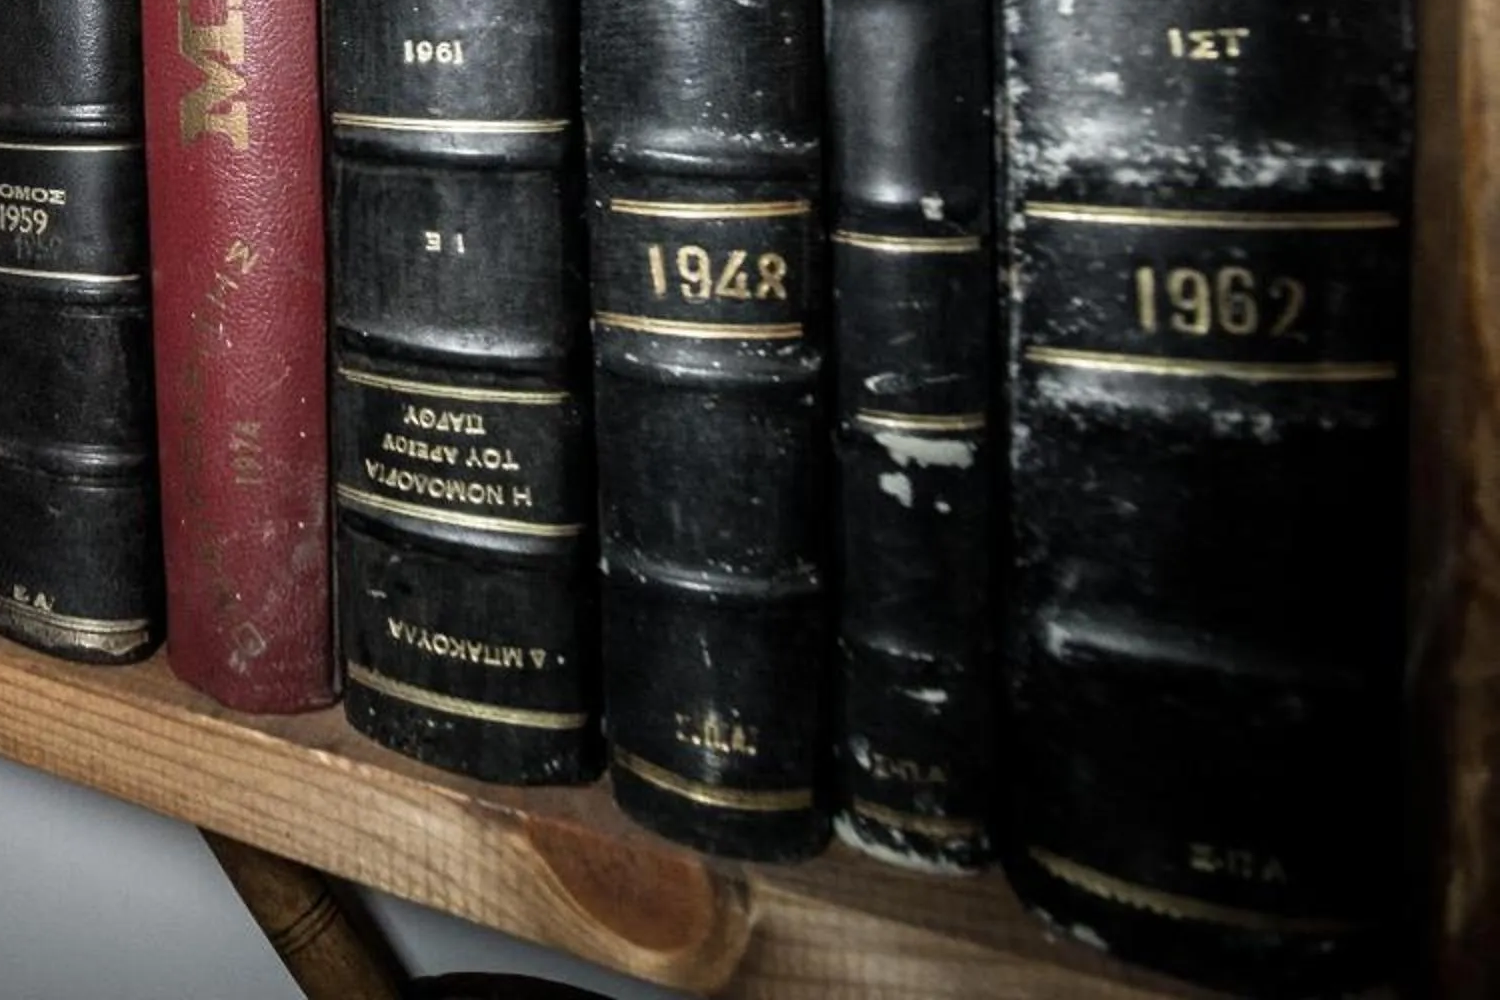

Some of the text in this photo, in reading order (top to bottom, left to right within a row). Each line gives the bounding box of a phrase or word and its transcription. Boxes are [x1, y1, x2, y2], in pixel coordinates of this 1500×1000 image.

[403, 38, 465, 66] 1961
[646, 244, 789, 304] 1948
[1134, 264, 1308, 342] 1962
[382, 432, 521, 471] ΤΟΥ ΑΡΕΙΟΥ
[364, 458, 532, 507] Η ΝΟΜΟΛΟΓΙΑ
[387, 617, 523, 668] ΜΠΑΚΟΥΛΑ
